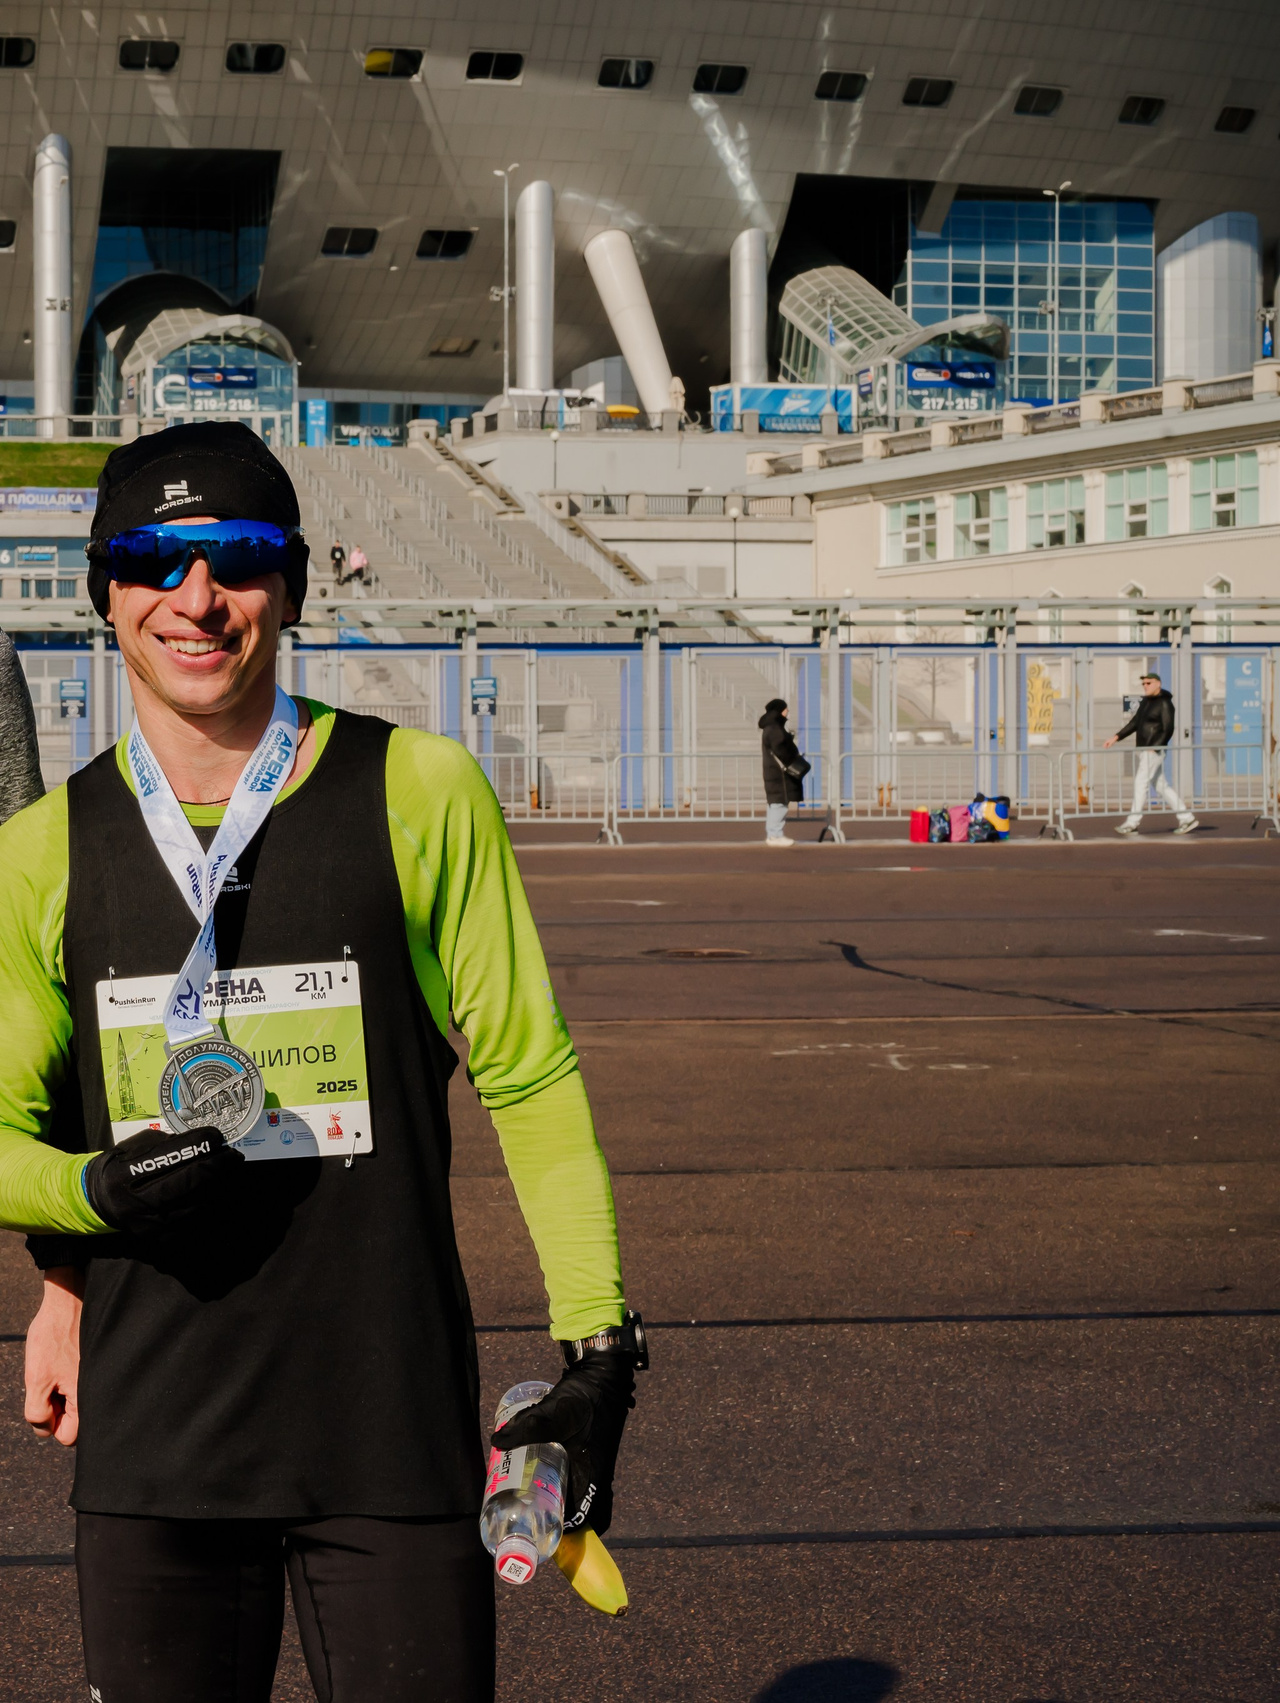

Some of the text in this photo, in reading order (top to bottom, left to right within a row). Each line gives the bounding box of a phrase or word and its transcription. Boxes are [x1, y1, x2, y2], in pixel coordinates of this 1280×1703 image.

[8, 493, 84, 505] ПЛОЩАДКА
[154, 494, 203, 514] NORDSKI
[130, 738, 154, 797] АРЕНА
[248, 727, 284, 792] ПОЛУМАРАФОН
[255, 732, 293, 792] АРЕНА
[220, 884, 251, 893] RDSKI
[203, 977, 265, 997] РЕНА
[295, 971, 333, 993] 21,1
[114, 997, 156, 1006] PushkinRun
[203, 995, 267, 1008] УМАРАФОН
[311, 992, 327, 1000] КМ
[205, 1006, 240, 1015] ПЕТЕРБУРГА
[178, 1043, 258, 1078] ПОЛУМАРАФОН
[253, 1044, 337, 1069] ШИЛОВ
[162, 1073, 174, 1112] АРЕНА
[316, 1079, 358, 1094] 2025
[223, 1130, 239, 1140] 025
[129, 1140, 211, 1176] NORDSKI
[501, 1450, 512, 1475] NHEIT
[563, 1483, 597, 1530] RDSKI
